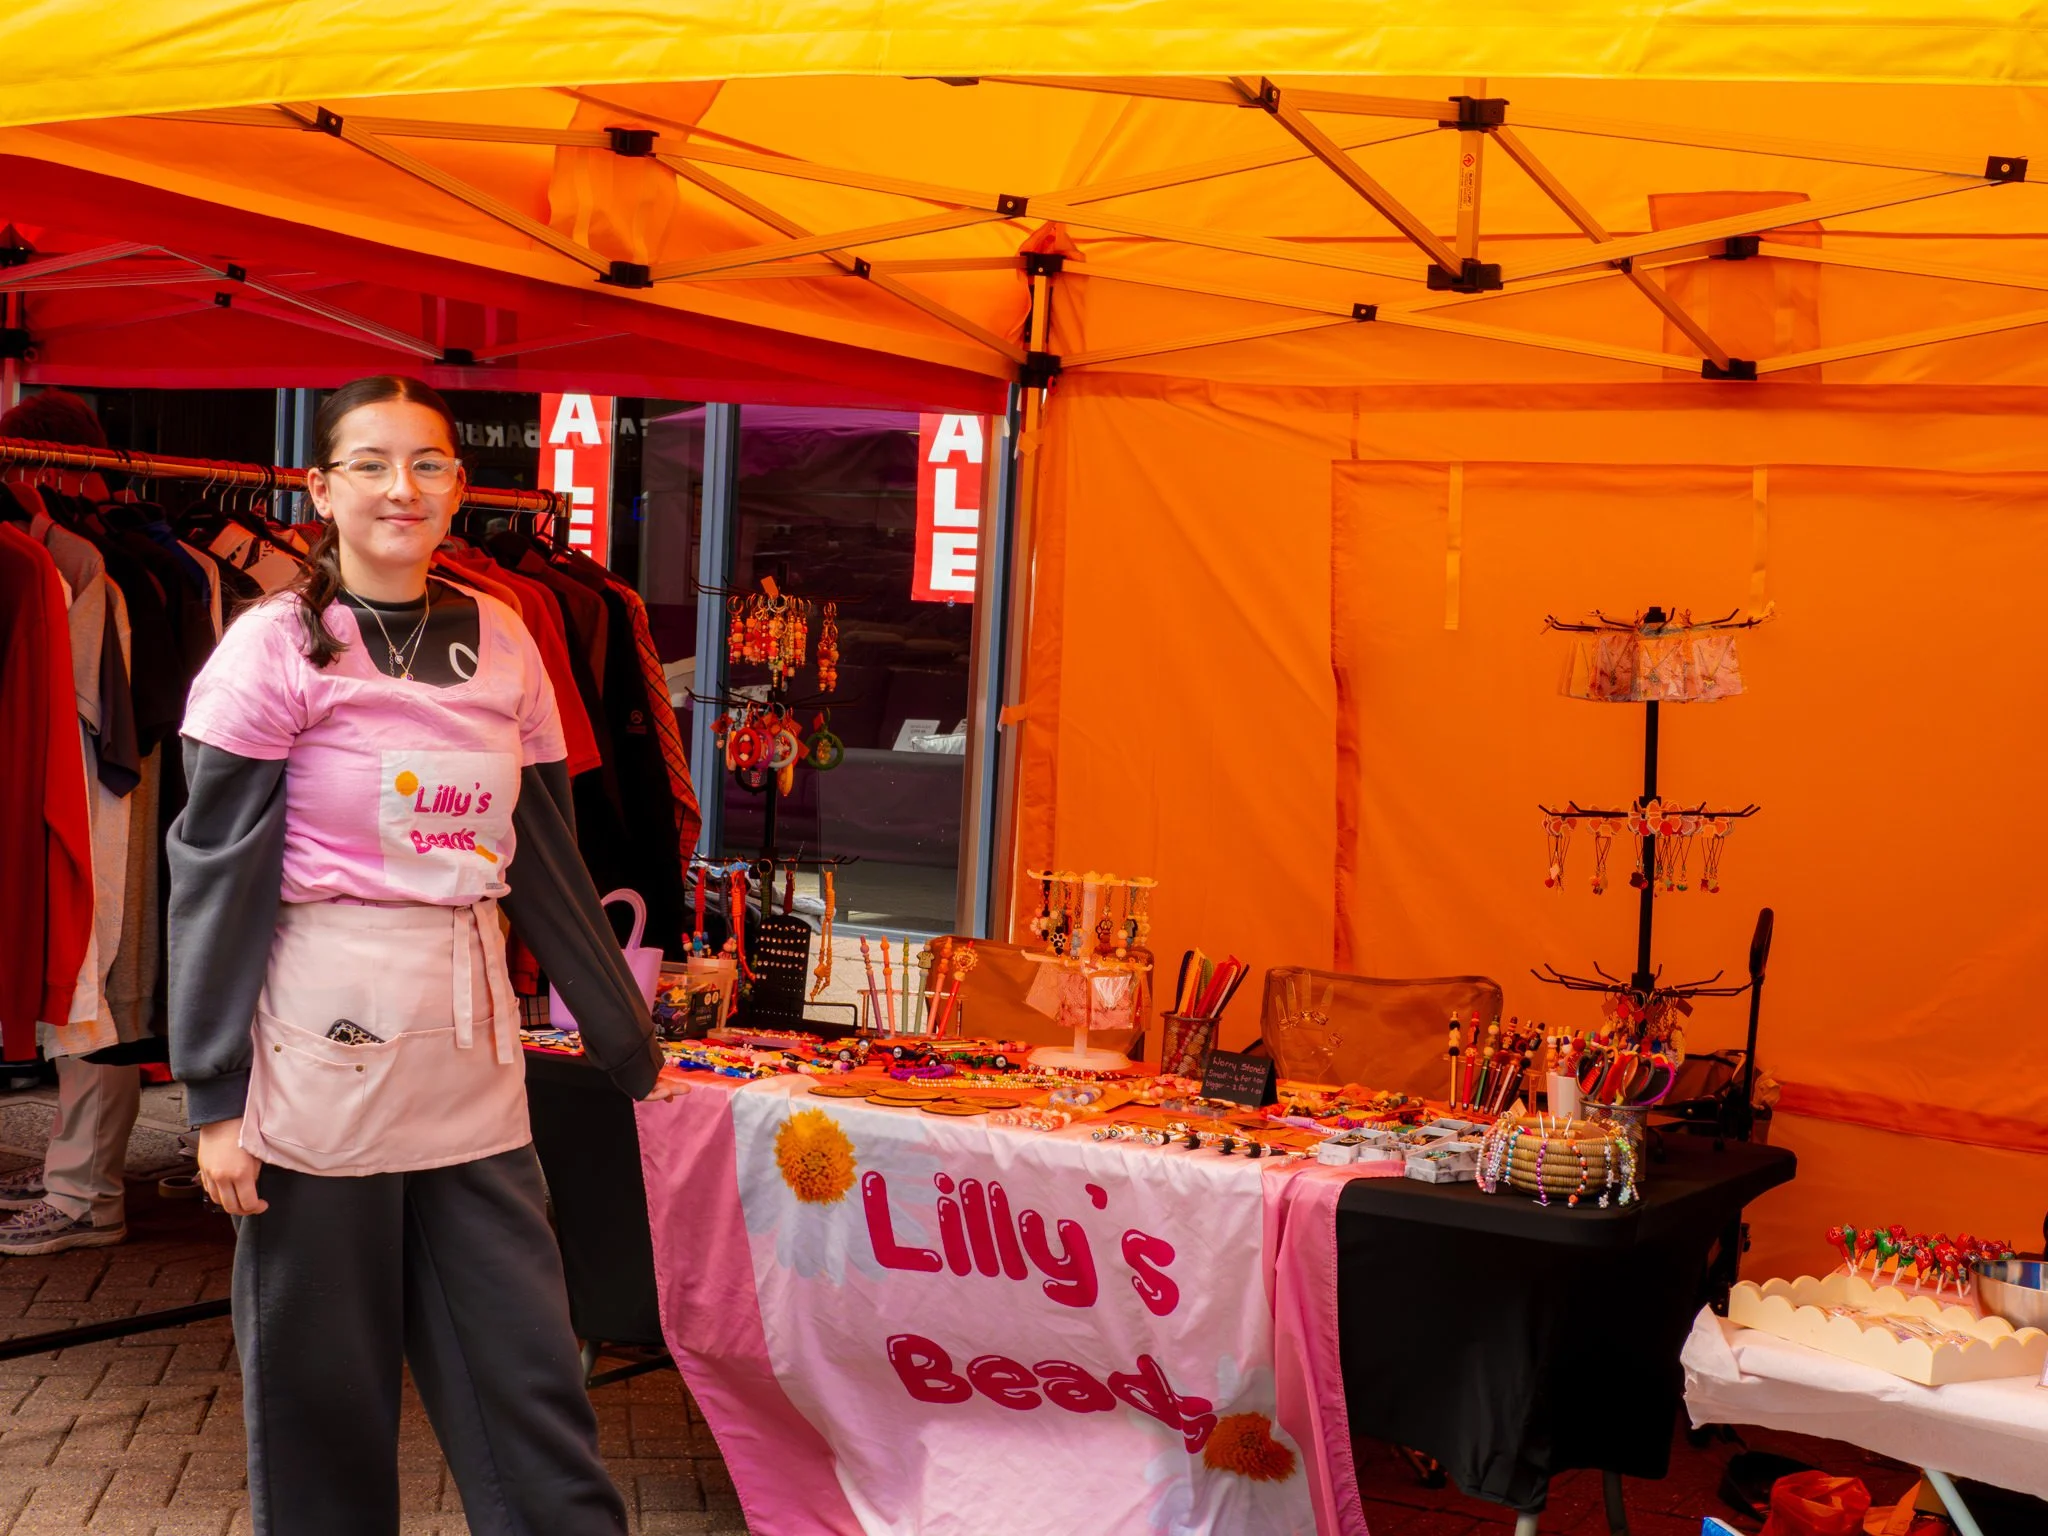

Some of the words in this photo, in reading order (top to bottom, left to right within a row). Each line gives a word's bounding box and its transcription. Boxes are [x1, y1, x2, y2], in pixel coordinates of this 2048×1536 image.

[413, 782, 493, 817] Lilly's
[408, 827, 477, 855] Beads
[862, 1170, 1180, 1317] Lilly's
[886, 1333, 1218, 1454] Beads
